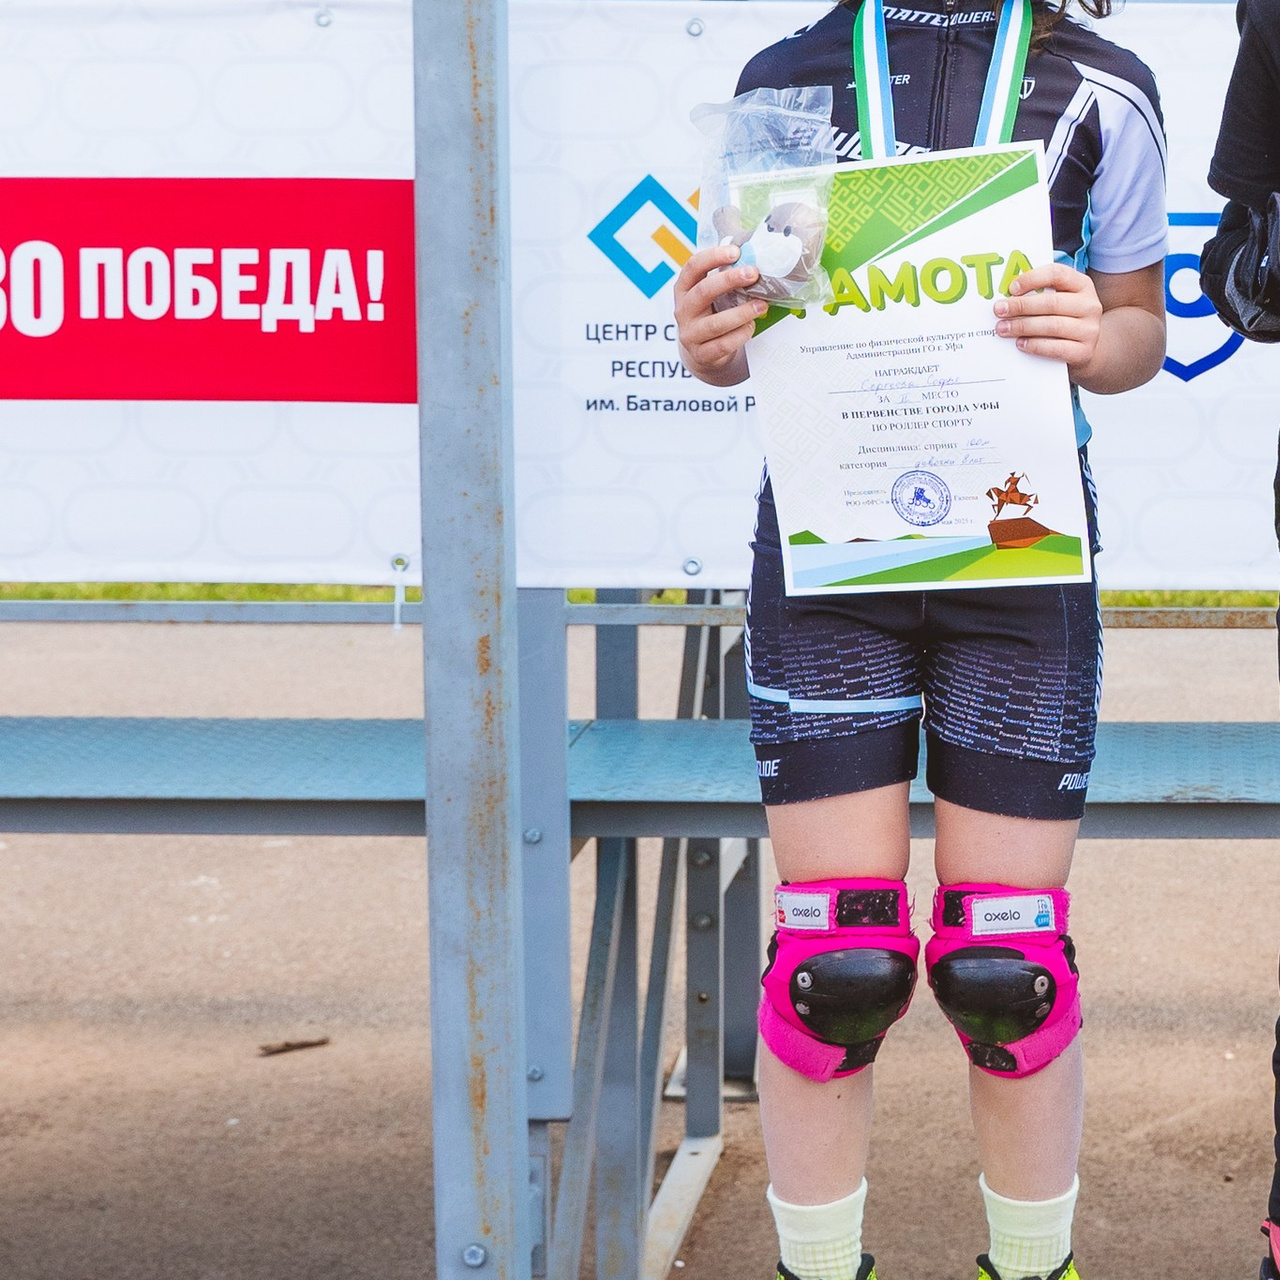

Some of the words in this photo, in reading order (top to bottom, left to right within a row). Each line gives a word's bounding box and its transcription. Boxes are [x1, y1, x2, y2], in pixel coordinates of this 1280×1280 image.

[79, 247, 385, 333] ПОБЕДА!
[586, 324, 657, 343] ЦЕНТР
[800, 340, 854, 354] Управление
[856, 342, 867, 350] по
[868, 335, 924, 351] физической
[926, 332, 966, 345] культуре
[846, 346, 921, 361] Администрации
[923, 344, 936, 354] ГО
[945, 342, 963, 354] Уфа
[874, 364, 940, 377] НАГРАЖДАЕТ
[586, 399, 619, 412] им.
[627, 395, 738, 412] Баталовой
[878, 395, 890, 404] ЗА
[922, 390, 959, 402] МЕСТО
[842, 411, 849, 420] В
[851, 407, 924, 420] ПЕРВЕНСТВЕ
[926, 404, 970, 416] ГОРОДА
[972, 401, 1000, 413] УФЫ
[872, 423, 887, 432] ПО
[889, 420, 929, 431] РОЛЛЕР
[931, 418, 973, 429] СПОРТУ
[858, 443, 922, 455] Дисциплина:
[924, 442, 957, 452] спринт
[839, 460, 887, 472] категория
[792, 906, 821, 918] oxelo
[984, 909, 1021, 922] oxelo
